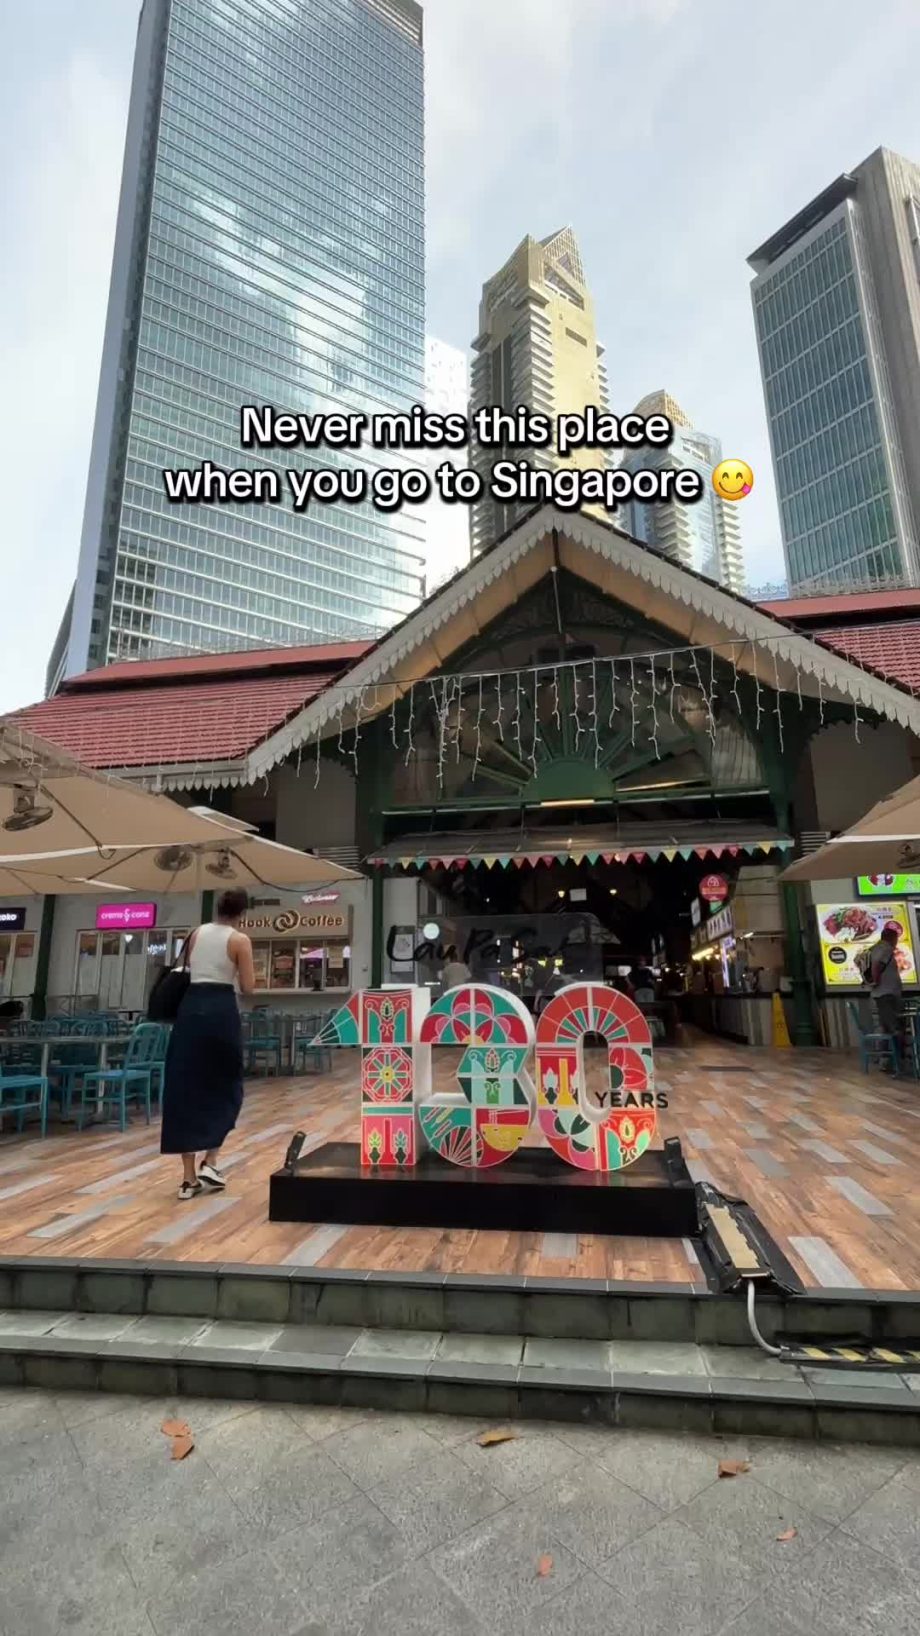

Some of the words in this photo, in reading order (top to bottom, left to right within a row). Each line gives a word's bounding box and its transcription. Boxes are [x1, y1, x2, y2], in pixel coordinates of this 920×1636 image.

[238, 916, 272, 929] Hook
[309, 981, 658, 1173] 130
[594, 1090, 669, 1109] YEARS
